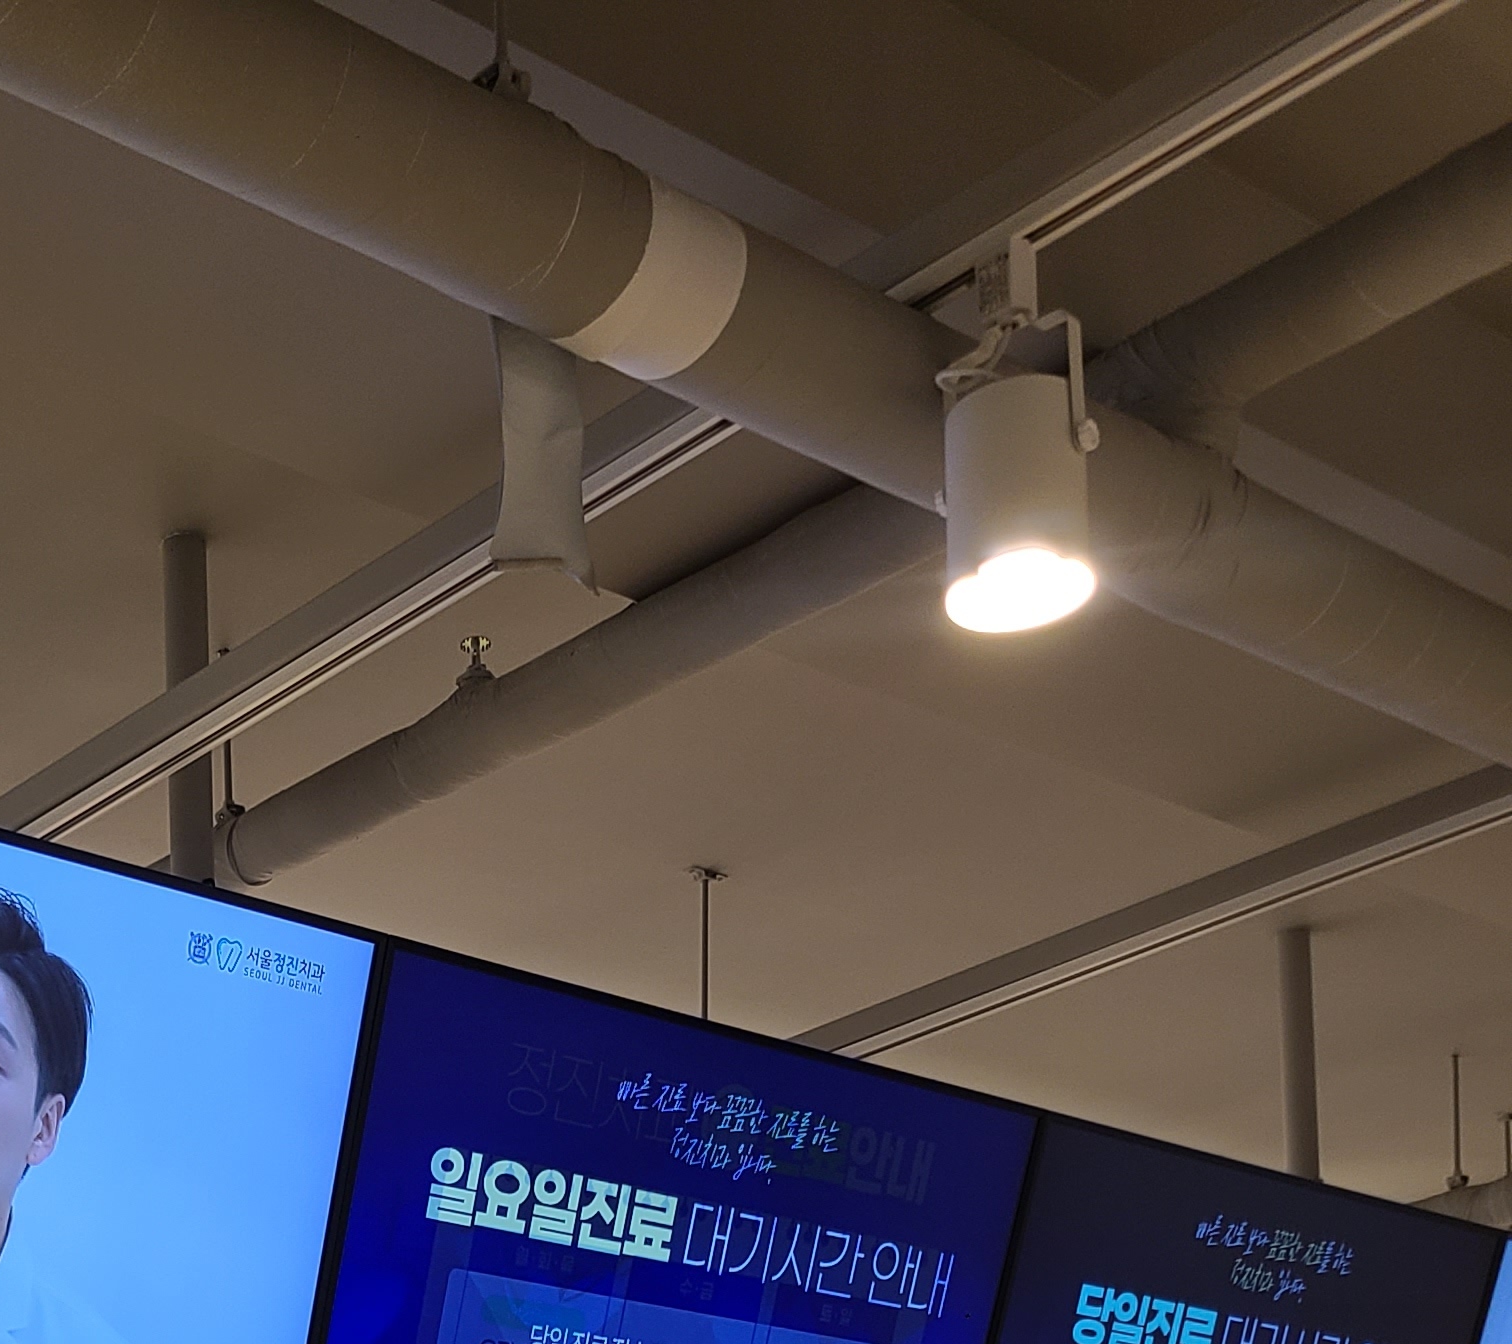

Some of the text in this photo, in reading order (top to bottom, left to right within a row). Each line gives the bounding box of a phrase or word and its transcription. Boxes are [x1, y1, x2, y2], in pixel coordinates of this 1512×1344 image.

[243, 966, 323, 996] SEOUL JJ DENTAL
[246, 946, 325, 983] 서울정진치과
[426, 1145, 955, 1318] 일요일진료 대기시간 안내
